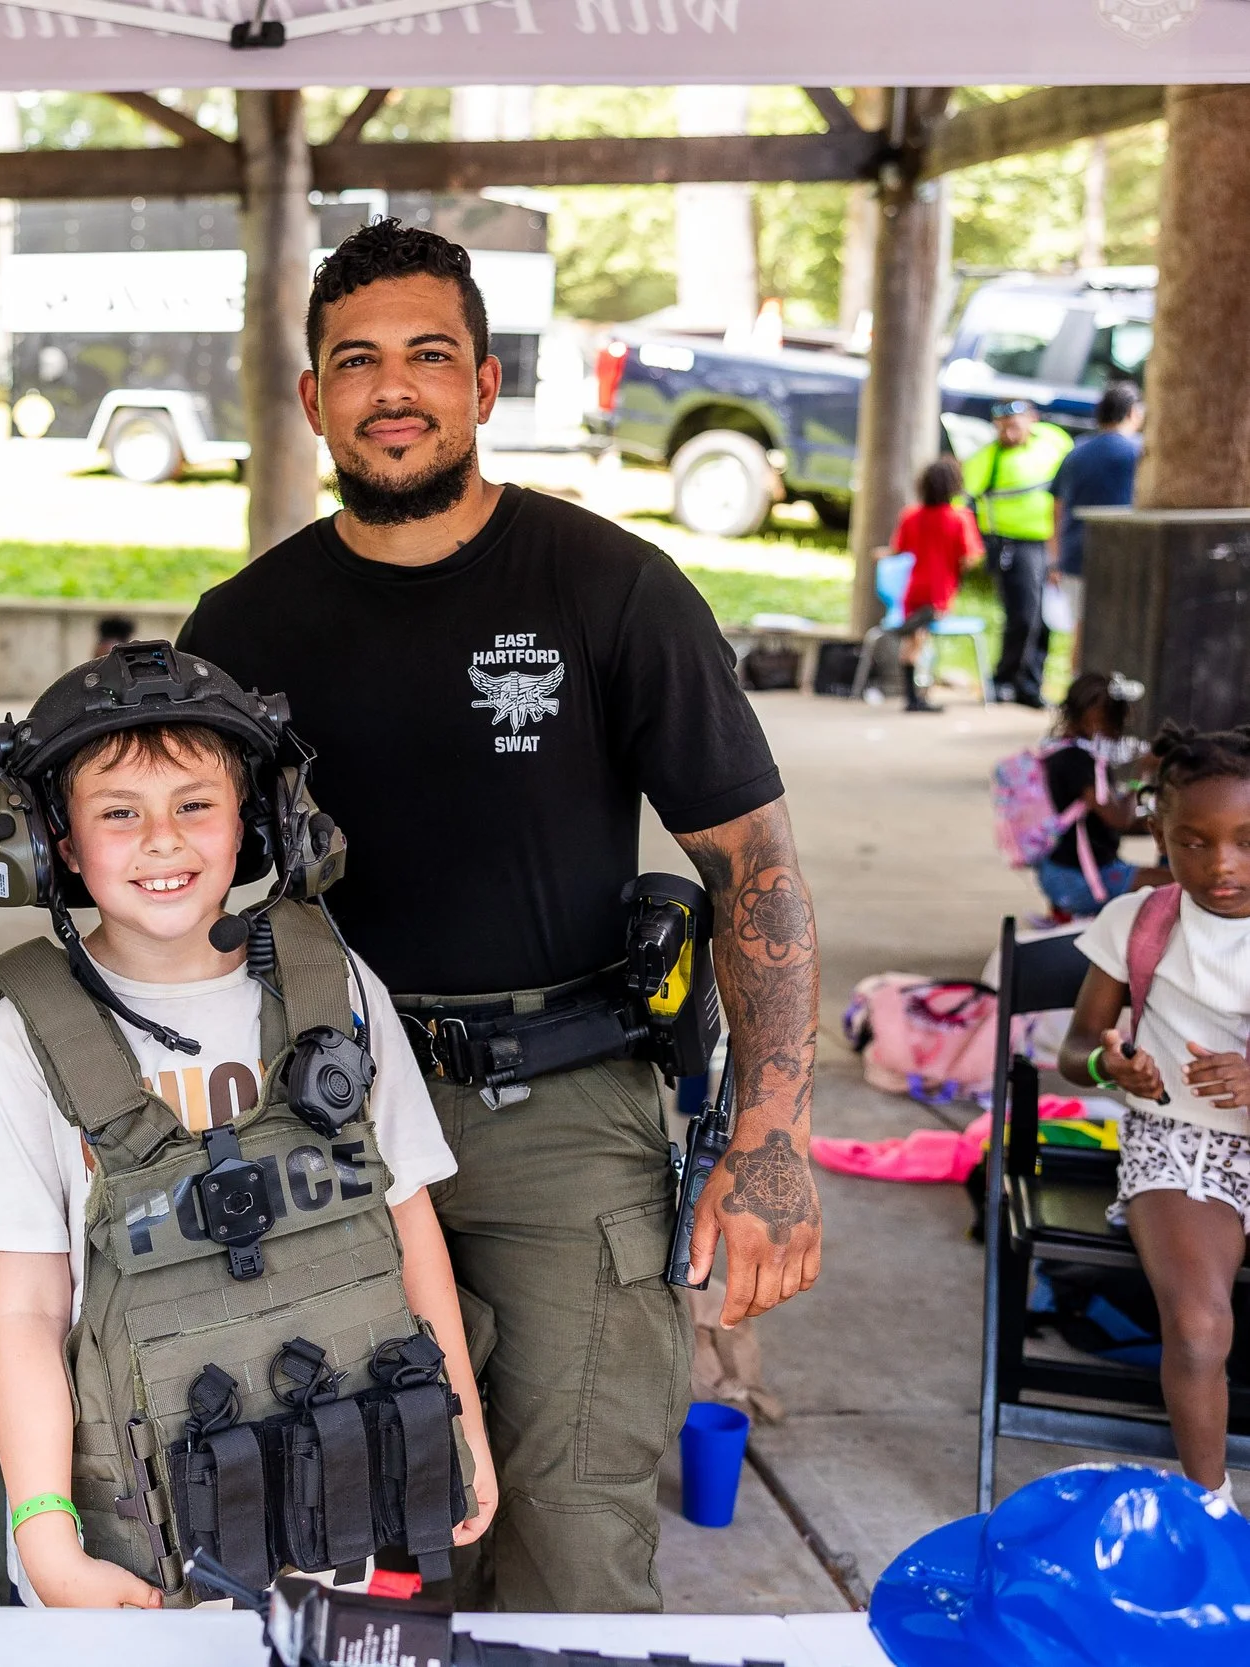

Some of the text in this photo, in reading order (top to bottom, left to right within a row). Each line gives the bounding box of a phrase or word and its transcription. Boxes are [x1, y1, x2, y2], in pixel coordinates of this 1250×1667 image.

[494, 633, 537, 648] EAST
[472, 649, 560, 665] HARTFORD
[494, 735, 540, 753] SWAT
[124, 1139, 373, 1257] POICE
